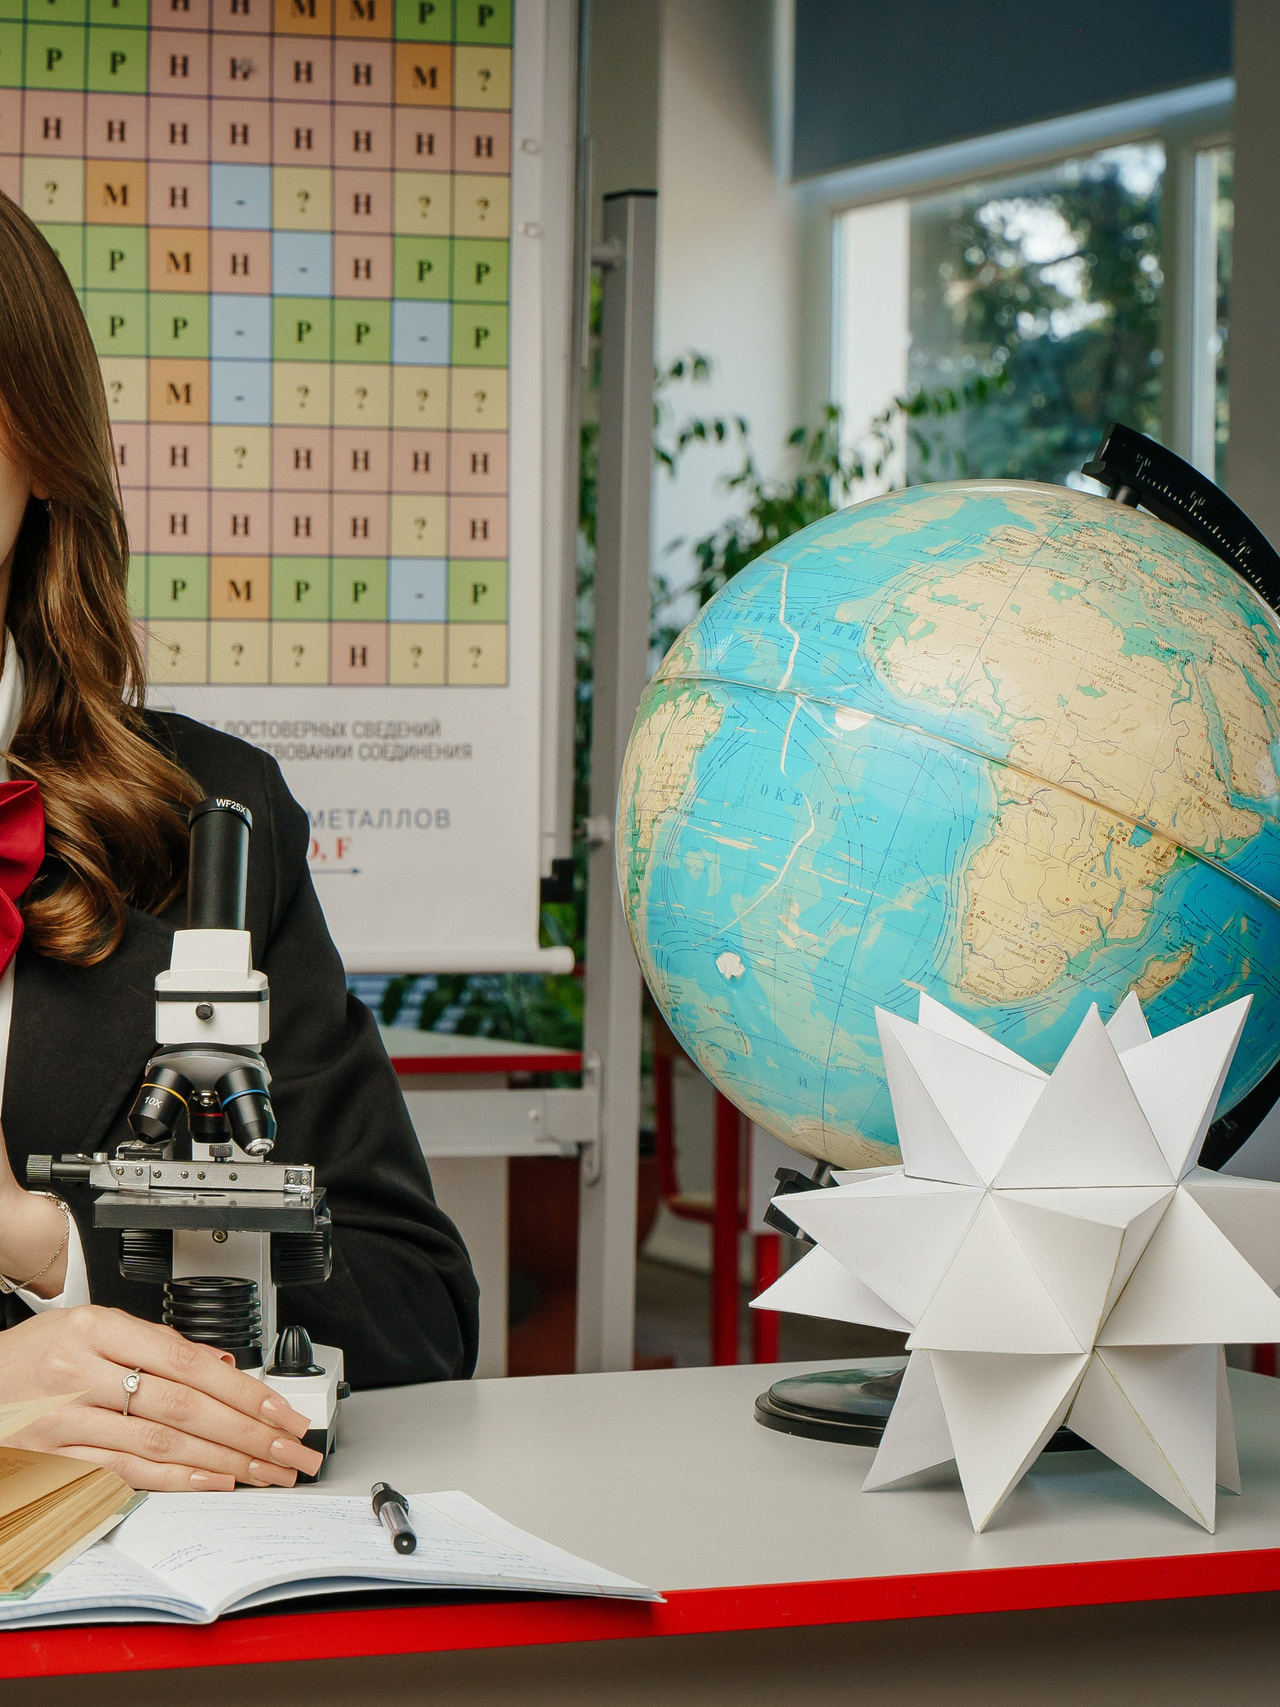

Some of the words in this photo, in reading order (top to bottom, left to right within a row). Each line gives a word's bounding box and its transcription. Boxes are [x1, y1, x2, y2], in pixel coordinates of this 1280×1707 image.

[477, 3, 495, 29] Р
[109, 50, 127, 75] Р
[169, 54, 190, 78] Н
[413, 65, 438, 90] М
[42, 116, 62, 140] Н
[230, 122, 249, 146] Н
[474, 135, 494, 159] Н
[104, 183, 129, 207] М
[353, 192, 372, 216] Н
[168, 251, 192, 274] М
[231, 253, 250, 276] Н
[353, 257, 372, 280] Н
[416, 259, 433, 283] Р
[109, 315, 125, 338] Р
[296, 320, 313, 344] Р
[474, 326, 490, 350] Р
[168, 382, 192, 405] М
[170, 445, 189, 468] Н
[294, 448, 312, 470] Н
[470, 452, 489, 475] Н
[231, 514, 250, 537] Н
[351, 516, 370, 539] Н
[171, 579, 187, 602] Р
[229, 579, 252, 602] М
[471, 582, 488, 605] Р
[350, 645, 368, 668] Н
[215, 798, 247, 815] WF25X
[759, 784, 843, 822] ОКЕАН
[144, 1095, 163, 1109] 10X
